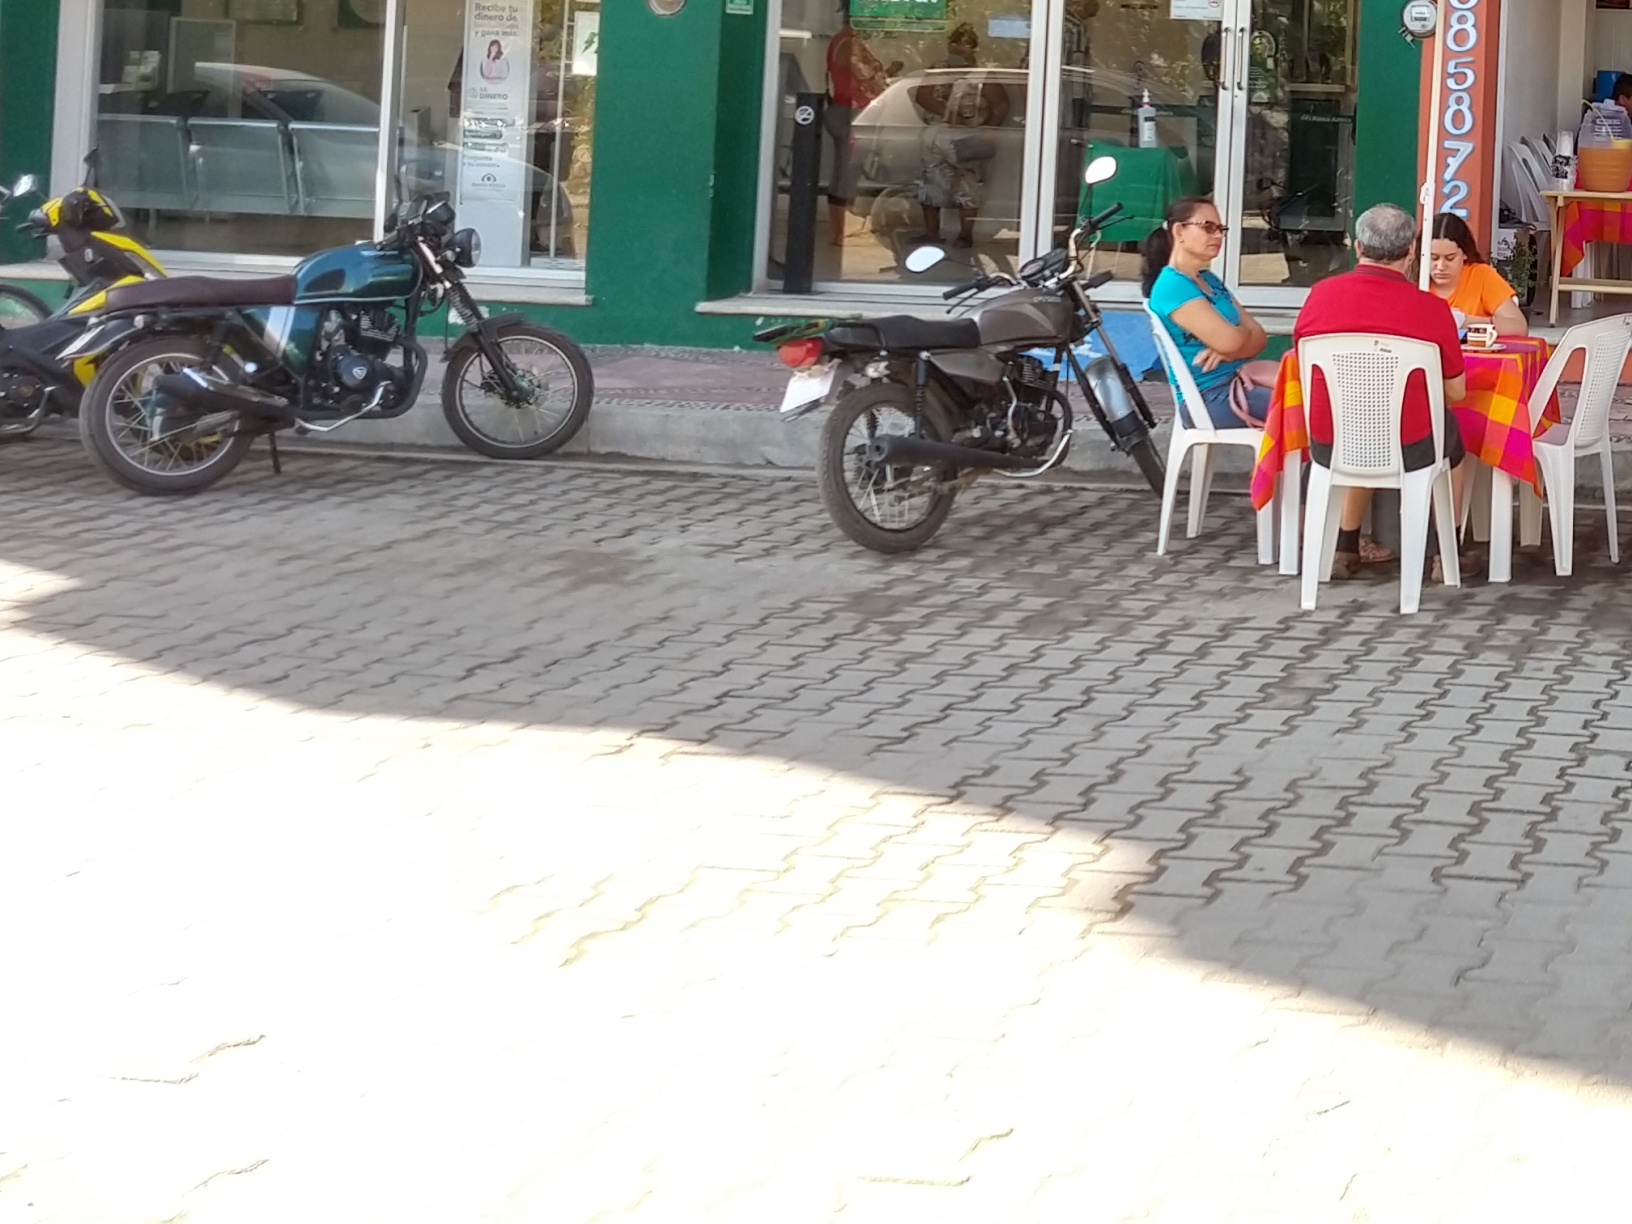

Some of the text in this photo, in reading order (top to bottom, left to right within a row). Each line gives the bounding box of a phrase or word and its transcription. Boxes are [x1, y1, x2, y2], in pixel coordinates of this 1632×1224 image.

[474, 3, 518, 13] Recibe tu
[474, 12, 518, 22] dinero de
